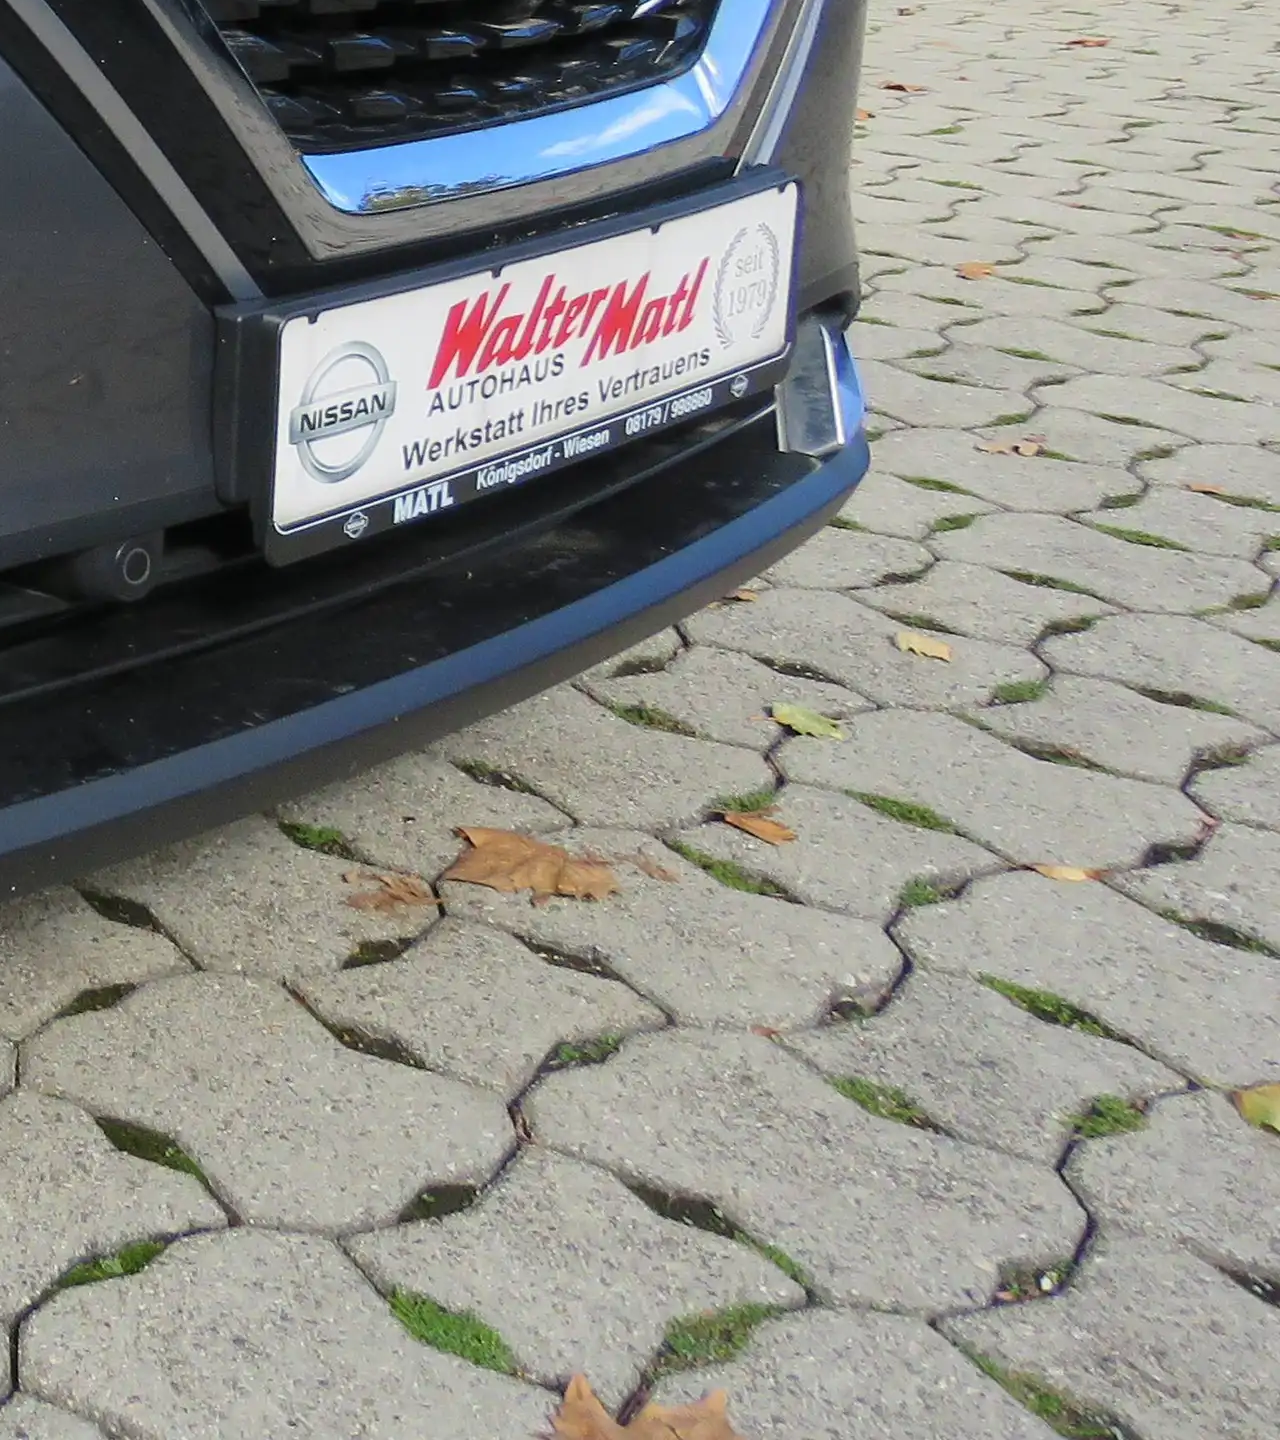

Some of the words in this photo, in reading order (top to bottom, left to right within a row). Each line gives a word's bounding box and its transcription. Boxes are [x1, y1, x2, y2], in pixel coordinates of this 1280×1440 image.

[735, 244, 763, 278] seit
[426, 273, 611, 390] Walter
[579, 256, 710, 368] Matl
[726, 279, 767, 317] 1979
[300, 391, 387, 433] NISSAN
[402, 412, 524, 471] Werkstatt
[531, 391, 589, 428] Ihres
[598, 346, 710, 403] Vertrauens
[428, 353, 565, 417] AUTOHAUS
[393, 481, 454, 523] MATL
[476, 446, 551, 490] Königsdorf
[563, 428, 610, 459] Wiesen
[625, 406, 662, 436] 08179
